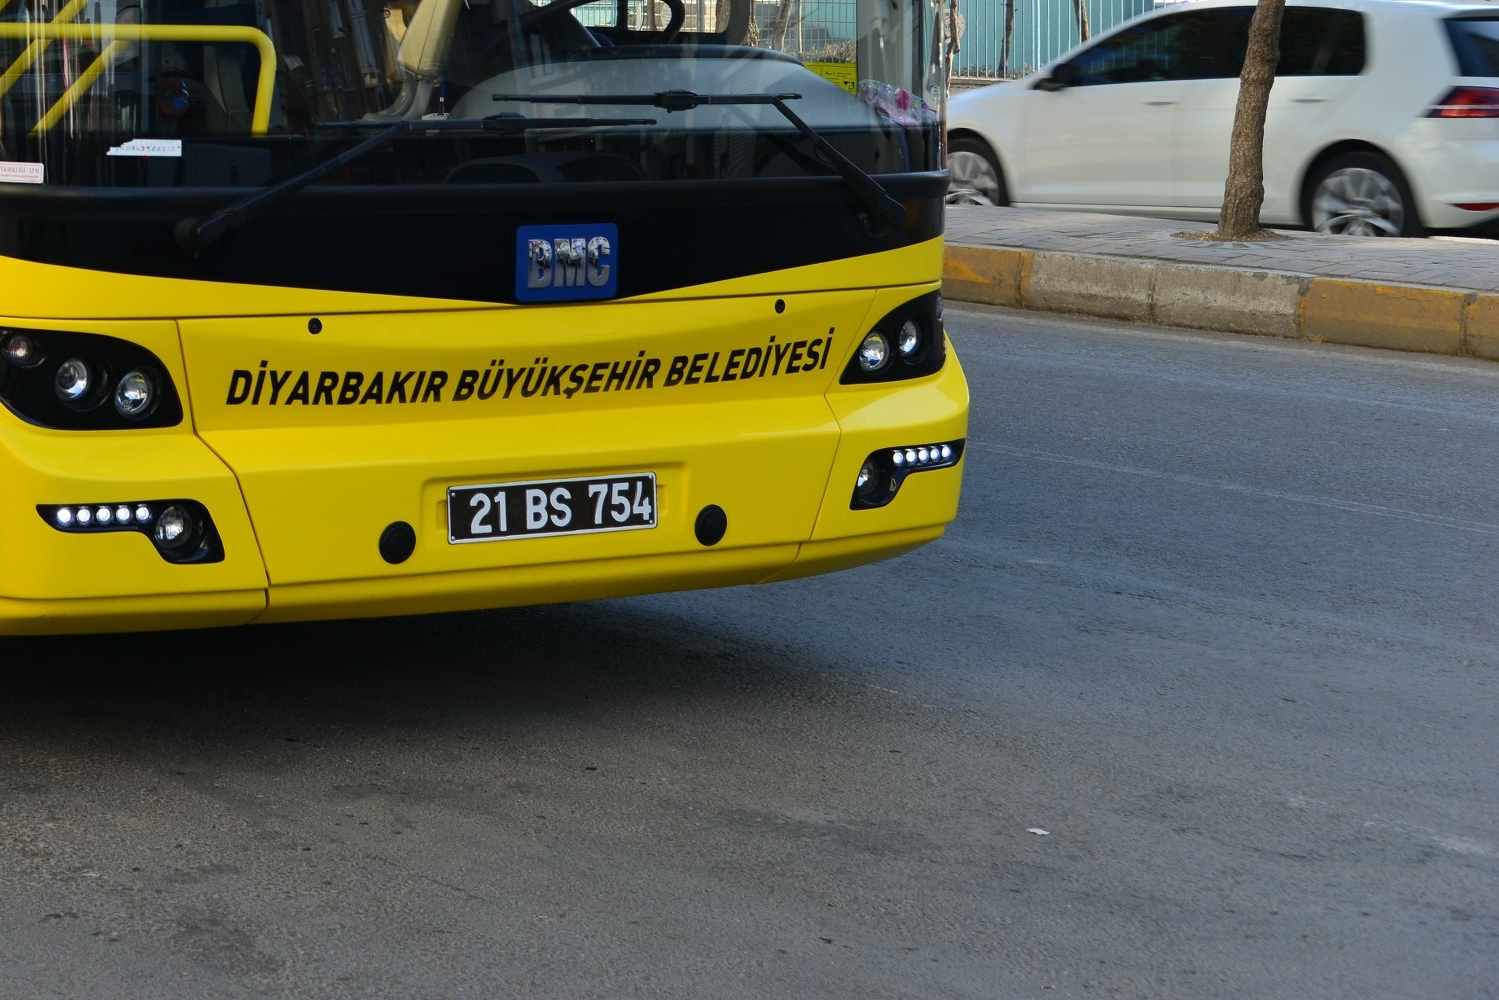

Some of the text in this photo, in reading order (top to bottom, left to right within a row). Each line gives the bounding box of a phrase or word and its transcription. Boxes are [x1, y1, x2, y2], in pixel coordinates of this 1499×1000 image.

[528, 236, 611, 289] BMC
[225, 327, 837, 406] DİYARBAKIR BÜYÜKŞEHİR BELEDİYESİ
[469, 480, 652, 534] 21 BS 754
